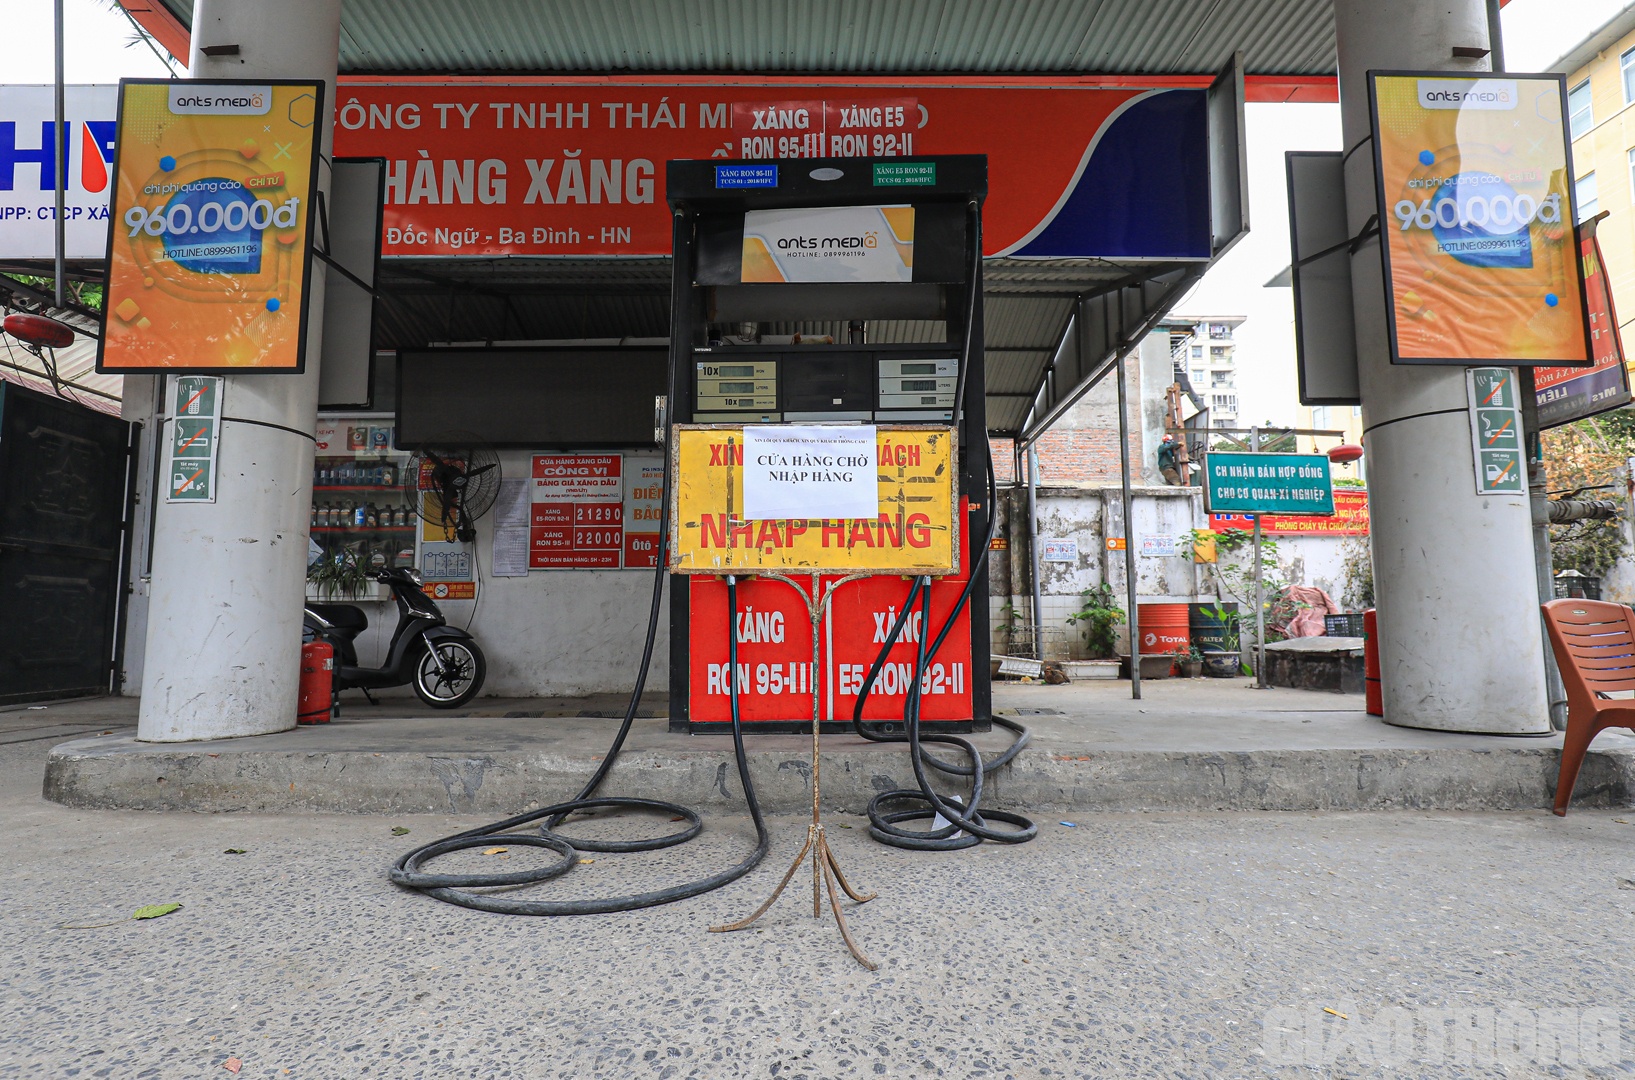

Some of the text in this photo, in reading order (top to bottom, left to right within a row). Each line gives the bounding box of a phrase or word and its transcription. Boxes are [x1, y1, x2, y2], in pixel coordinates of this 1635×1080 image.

[333, 97, 421, 130] ÔNG
[432, 103, 480, 129] TY
[489, 102, 589, 129] TNHH
[601, 96, 686, 129] THÁI
[752, 106, 809, 130] XĂNG
[839, 104, 882, 128] XĂNG
[885, 106, 905, 127] E5
[741, 136, 774, 159] RON
[831, 133, 912, 157] RON 92-II
[383, 148, 655, 205] HÀNG XĂNG
[0, 207, 31, 220] PP:
[124, 197, 300, 238] 960.000đ
[1394, 193, 1561, 231] 960.000đ
[386, 224, 428, 245] Đốc
[434, 227, 480, 249] Ngữ
[499, 227, 526, 244] Ba
[532, 227, 580, 244] Đình
[601, 226, 631, 244] HN
[1437, 240, 1476, 252] HOTLINE:
[162, 244, 257, 259] HOTLINE: 0899961196
[792, 453, 833, 467] HÀNG
[1215, 465, 1228, 477] CH
[812, 470, 854, 483] HÀNG
[1218, 487, 1234, 499] CHO
[707, 662, 750, 695] RON
[839, 663, 865, 695] E5
